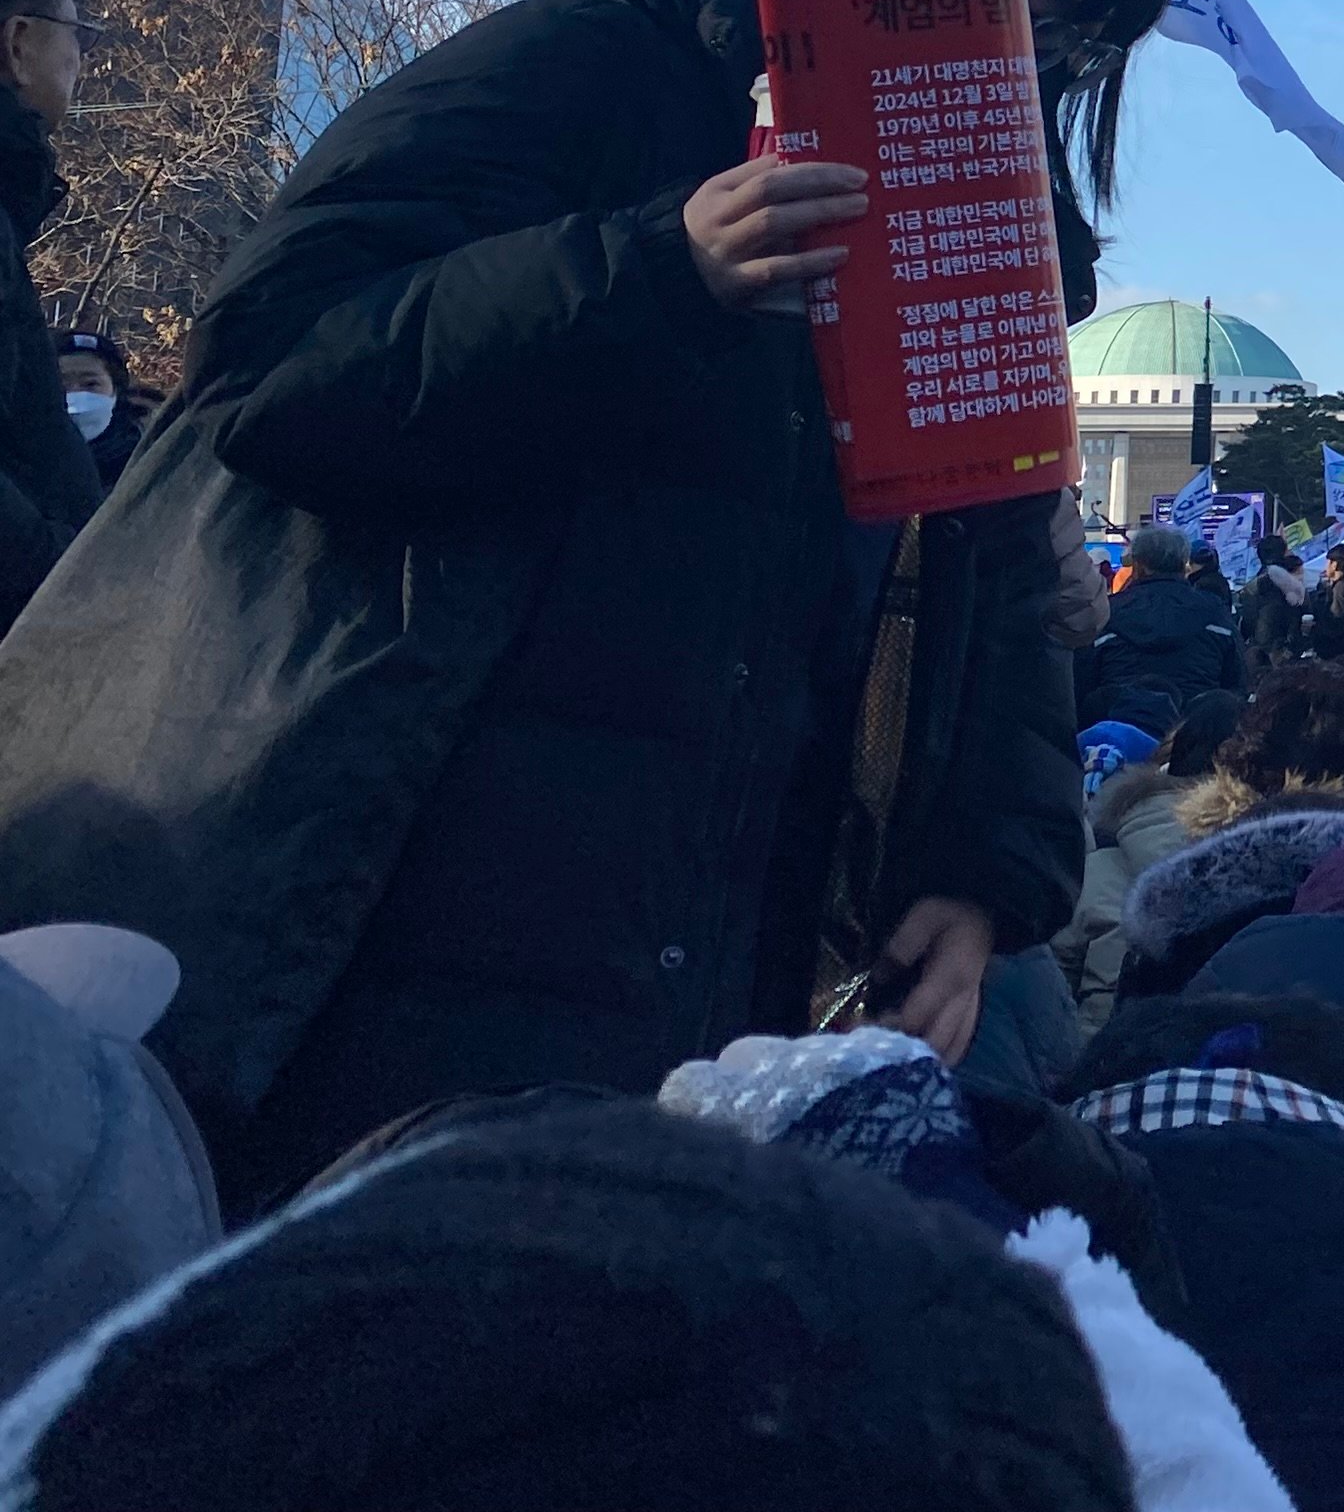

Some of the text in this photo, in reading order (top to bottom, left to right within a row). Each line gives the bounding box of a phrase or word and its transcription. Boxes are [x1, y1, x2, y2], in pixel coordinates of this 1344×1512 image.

[871, 63, 930, 87] 21세기
[873, 88, 937, 113] 2024년
[942, 83, 982, 105] 12월
[985, 81, 1013, 101] 3일
[876, 113, 940, 137] 1979년
[944, 109, 980, 130] 이후
[984, 105, 1022, 126] 45년
[878, 142, 915, 163] 이는
[920, 134, 974, 159] 국민의
[886, 210, 923, 232] 지금
[926, 198, 1017, 227] 대한민국에
[888, 235, 925, 256] 지금
[929, 223, 1020, 252] 대한민국에
[892, 260, 928, 281] 지금
[932, 248, 1022, 277] 대한민국에
[961, 295, 997, 319] 달한
[900, 327, 937, 350] 피와
[941, 321, 996, 346] 눈물로
[998, 313, 1047, 338] 이뤄낸
[903, 350, 958, 376] 계엄의
[961, 345, 997, 368] 밤이
[1001, 340, 1034, 363] 가고
[906, 378, 943, 402] 우리
[947, 370, 999, 396] 서로를
[907, 404, 946, 429] 함께
[949, 392, 1019, 423] 담대하게
